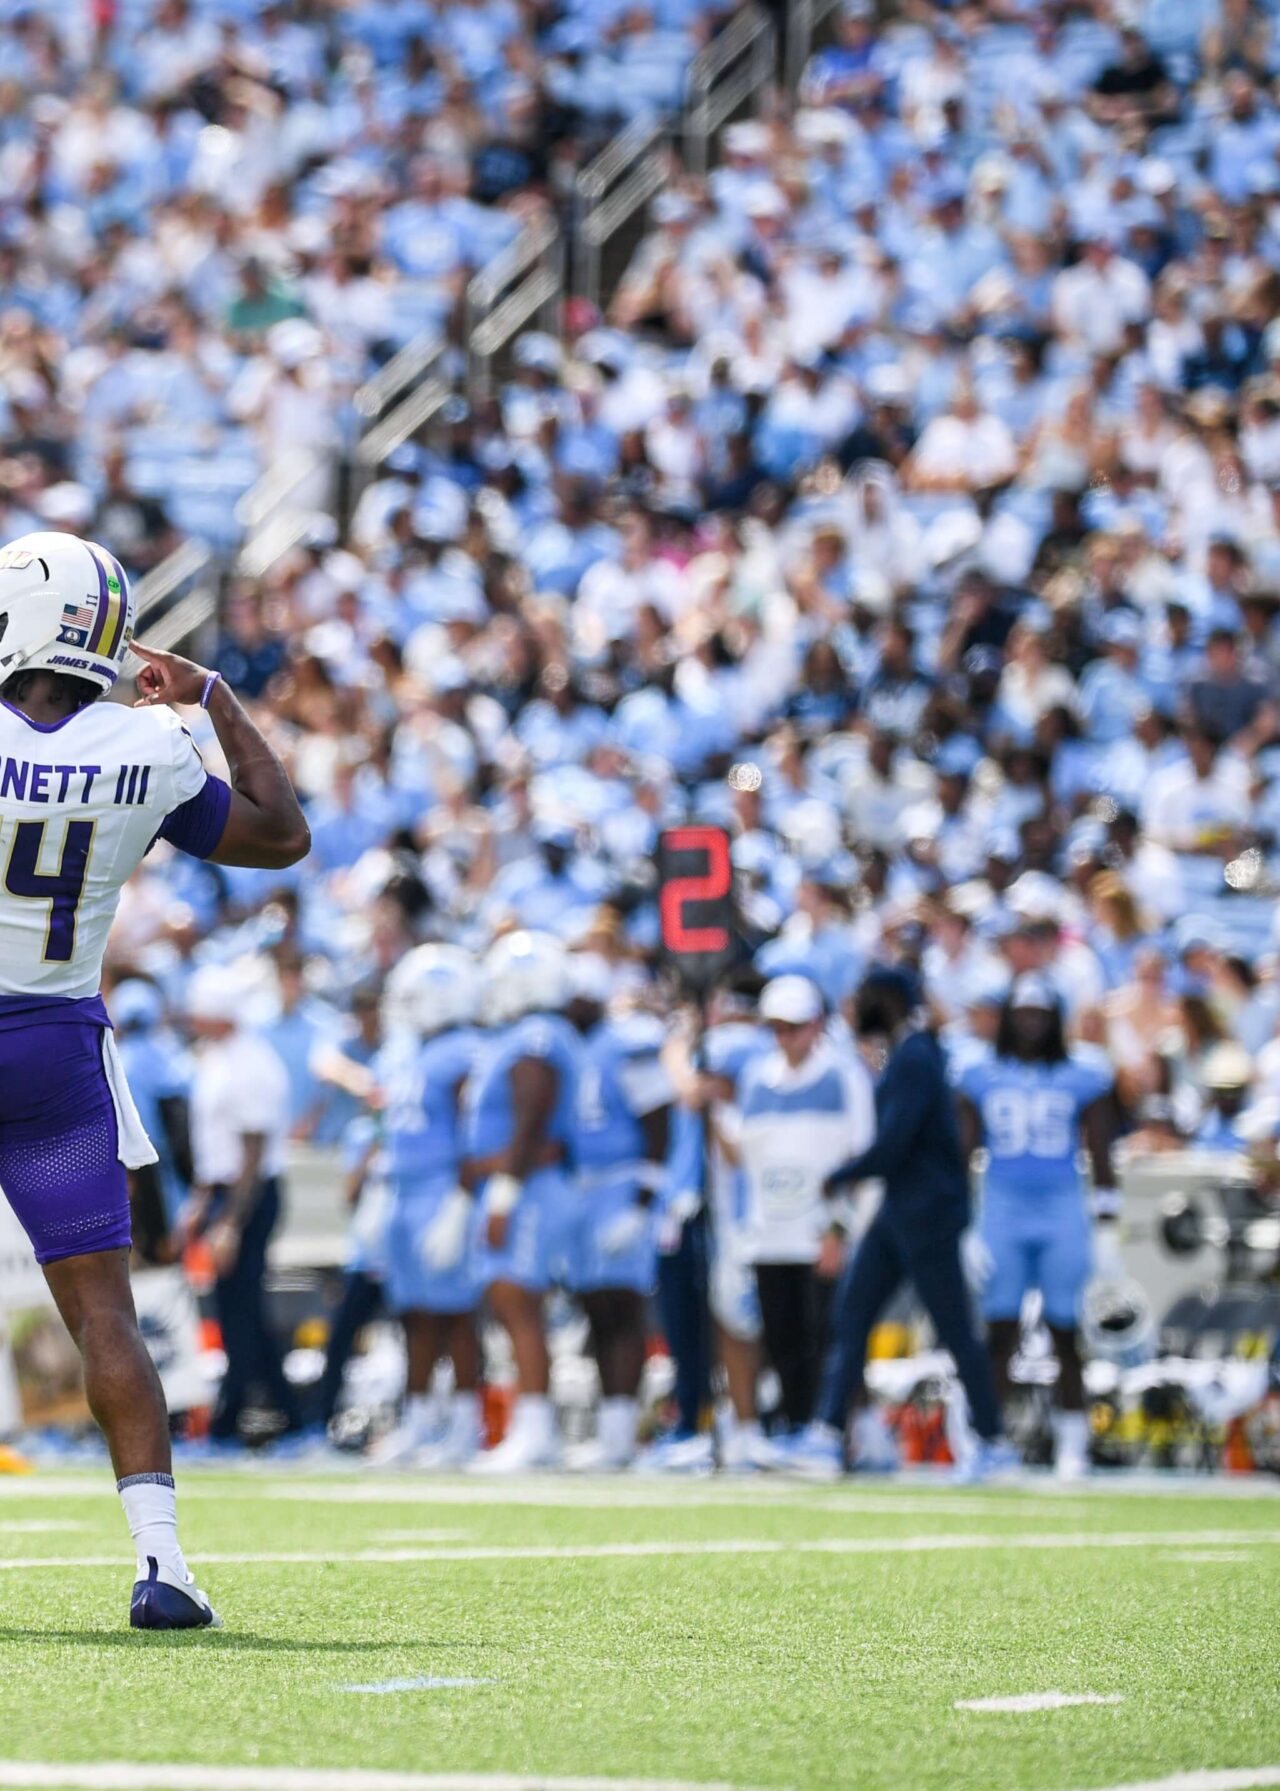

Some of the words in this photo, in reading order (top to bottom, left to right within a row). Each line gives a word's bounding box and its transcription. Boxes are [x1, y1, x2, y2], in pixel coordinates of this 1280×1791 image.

[46, 655, 90, 669] JAMES
[113, 764, 151, 805] III
[659, 826, 731, 952] 2
[981, 1087, 1075, 1159] 95
